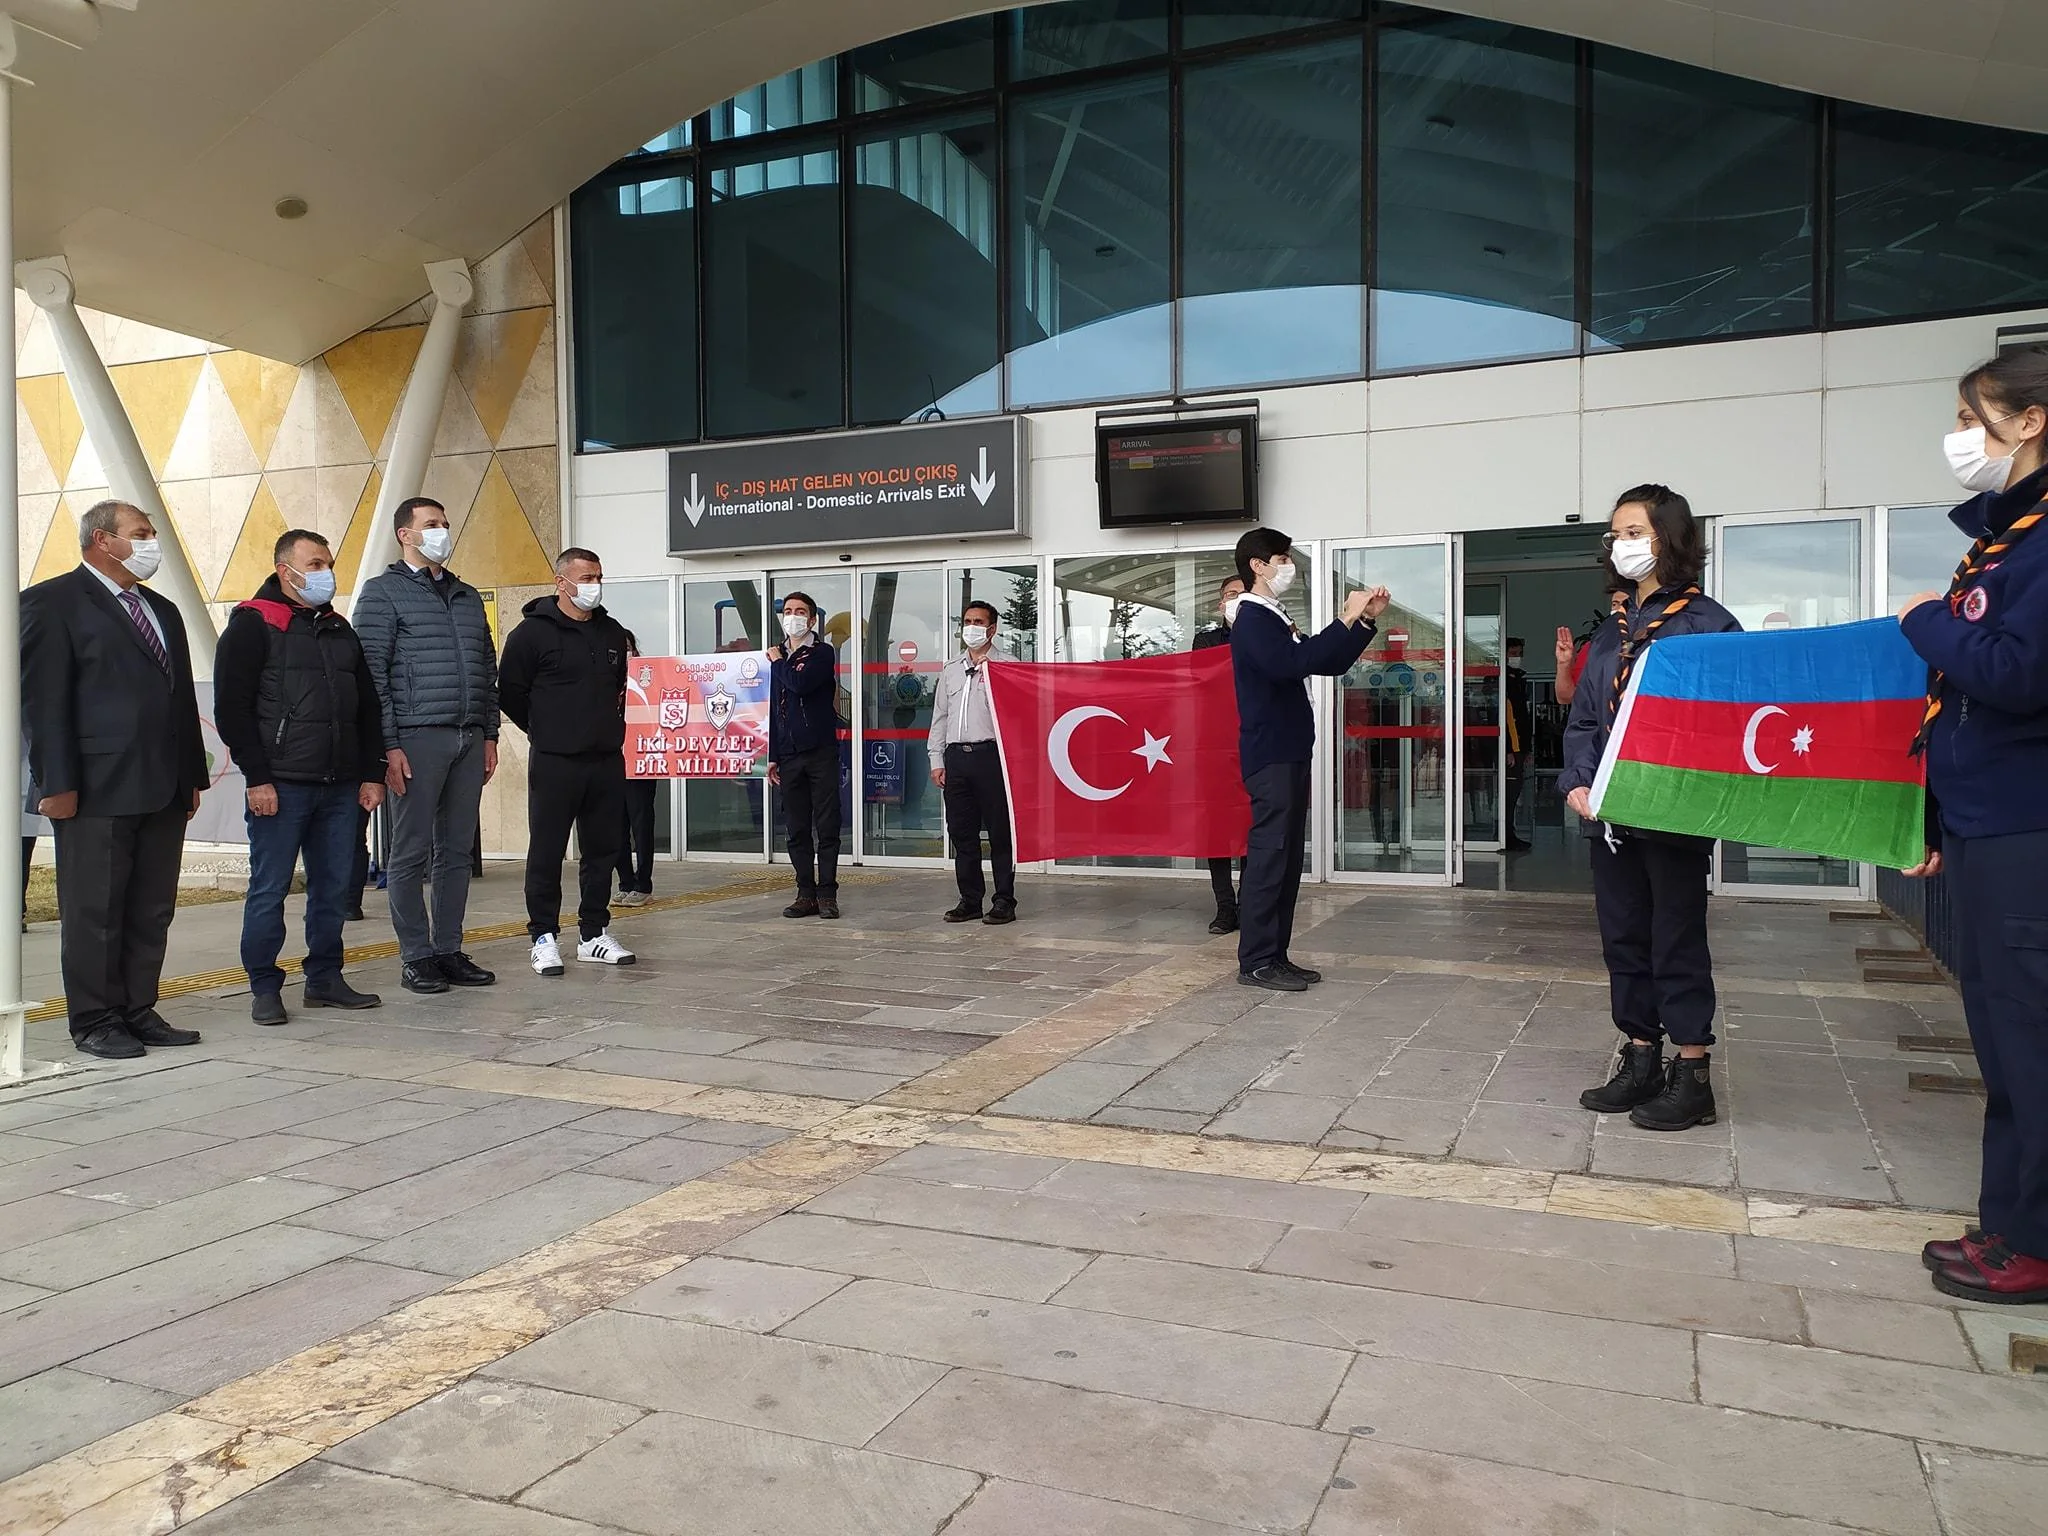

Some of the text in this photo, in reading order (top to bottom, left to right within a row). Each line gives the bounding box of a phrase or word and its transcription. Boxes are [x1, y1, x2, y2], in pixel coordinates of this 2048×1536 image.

[1121, 440, 1152, 449] ARRIVAL
[715, 481, 729, 500] İÇ
[742, 480, 766, 497] DIŞ
[770, 478, 798, 493] HAT
[803, 472, 853, 490] GELEN
[858, 467, 910, 486] YOLCU
[914, 463, 958, 484] ÇIKIŞ
[709, 496, 793, 516] International
[806, 491, 873, 510] Domestic
[876, 486, 933, 504] Arrivals
[937, 483, 966, 499] Exit
[675, 662, 727, 673] 05.11.2020
[687, 673, 714, 682] 20:55
[636, 733, 755, 753] İKİ DEVLET
[635, 753, 755, 775] BİR MİLLET
